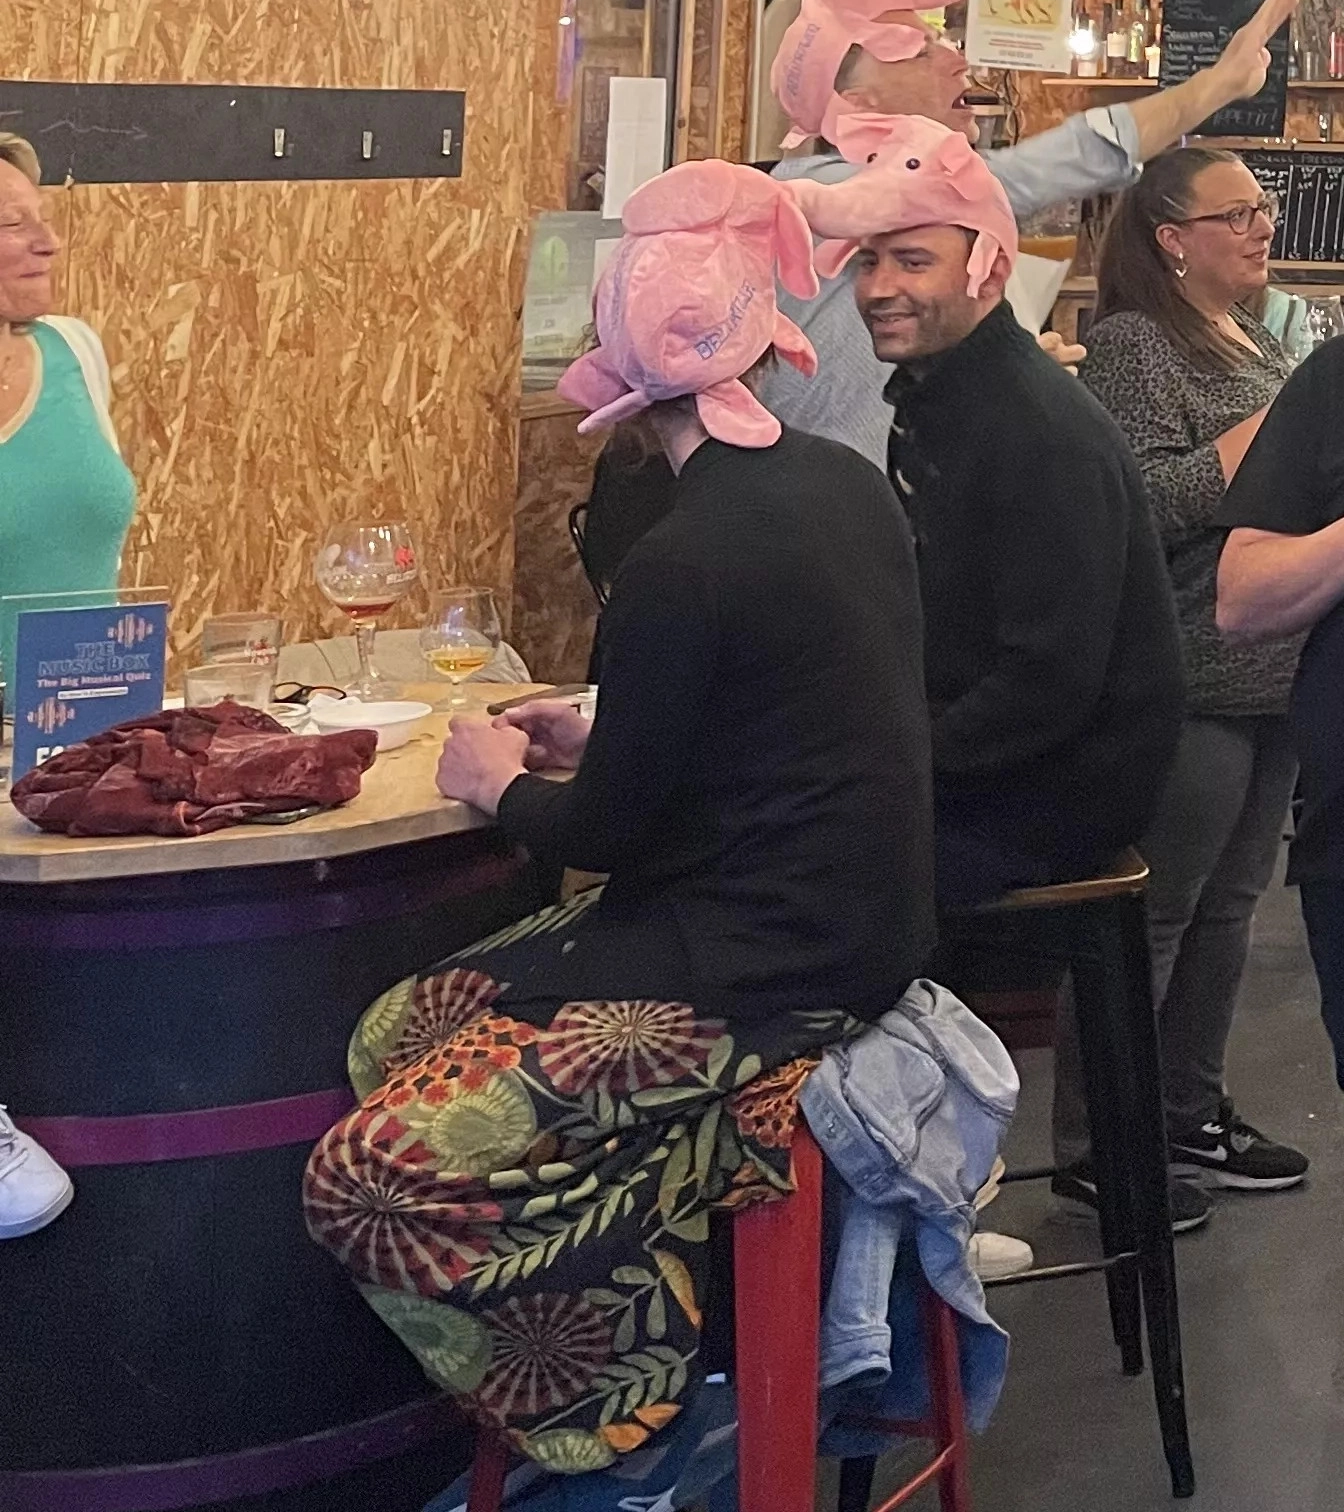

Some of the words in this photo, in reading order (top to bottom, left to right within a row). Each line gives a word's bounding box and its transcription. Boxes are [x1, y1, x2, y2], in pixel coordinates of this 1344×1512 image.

[37, 678, 59, 688] The
[60, 677, 79, 687] Big
[81, 672, 124, 686] Musical
[125, 671, 152, 683] Quiz
